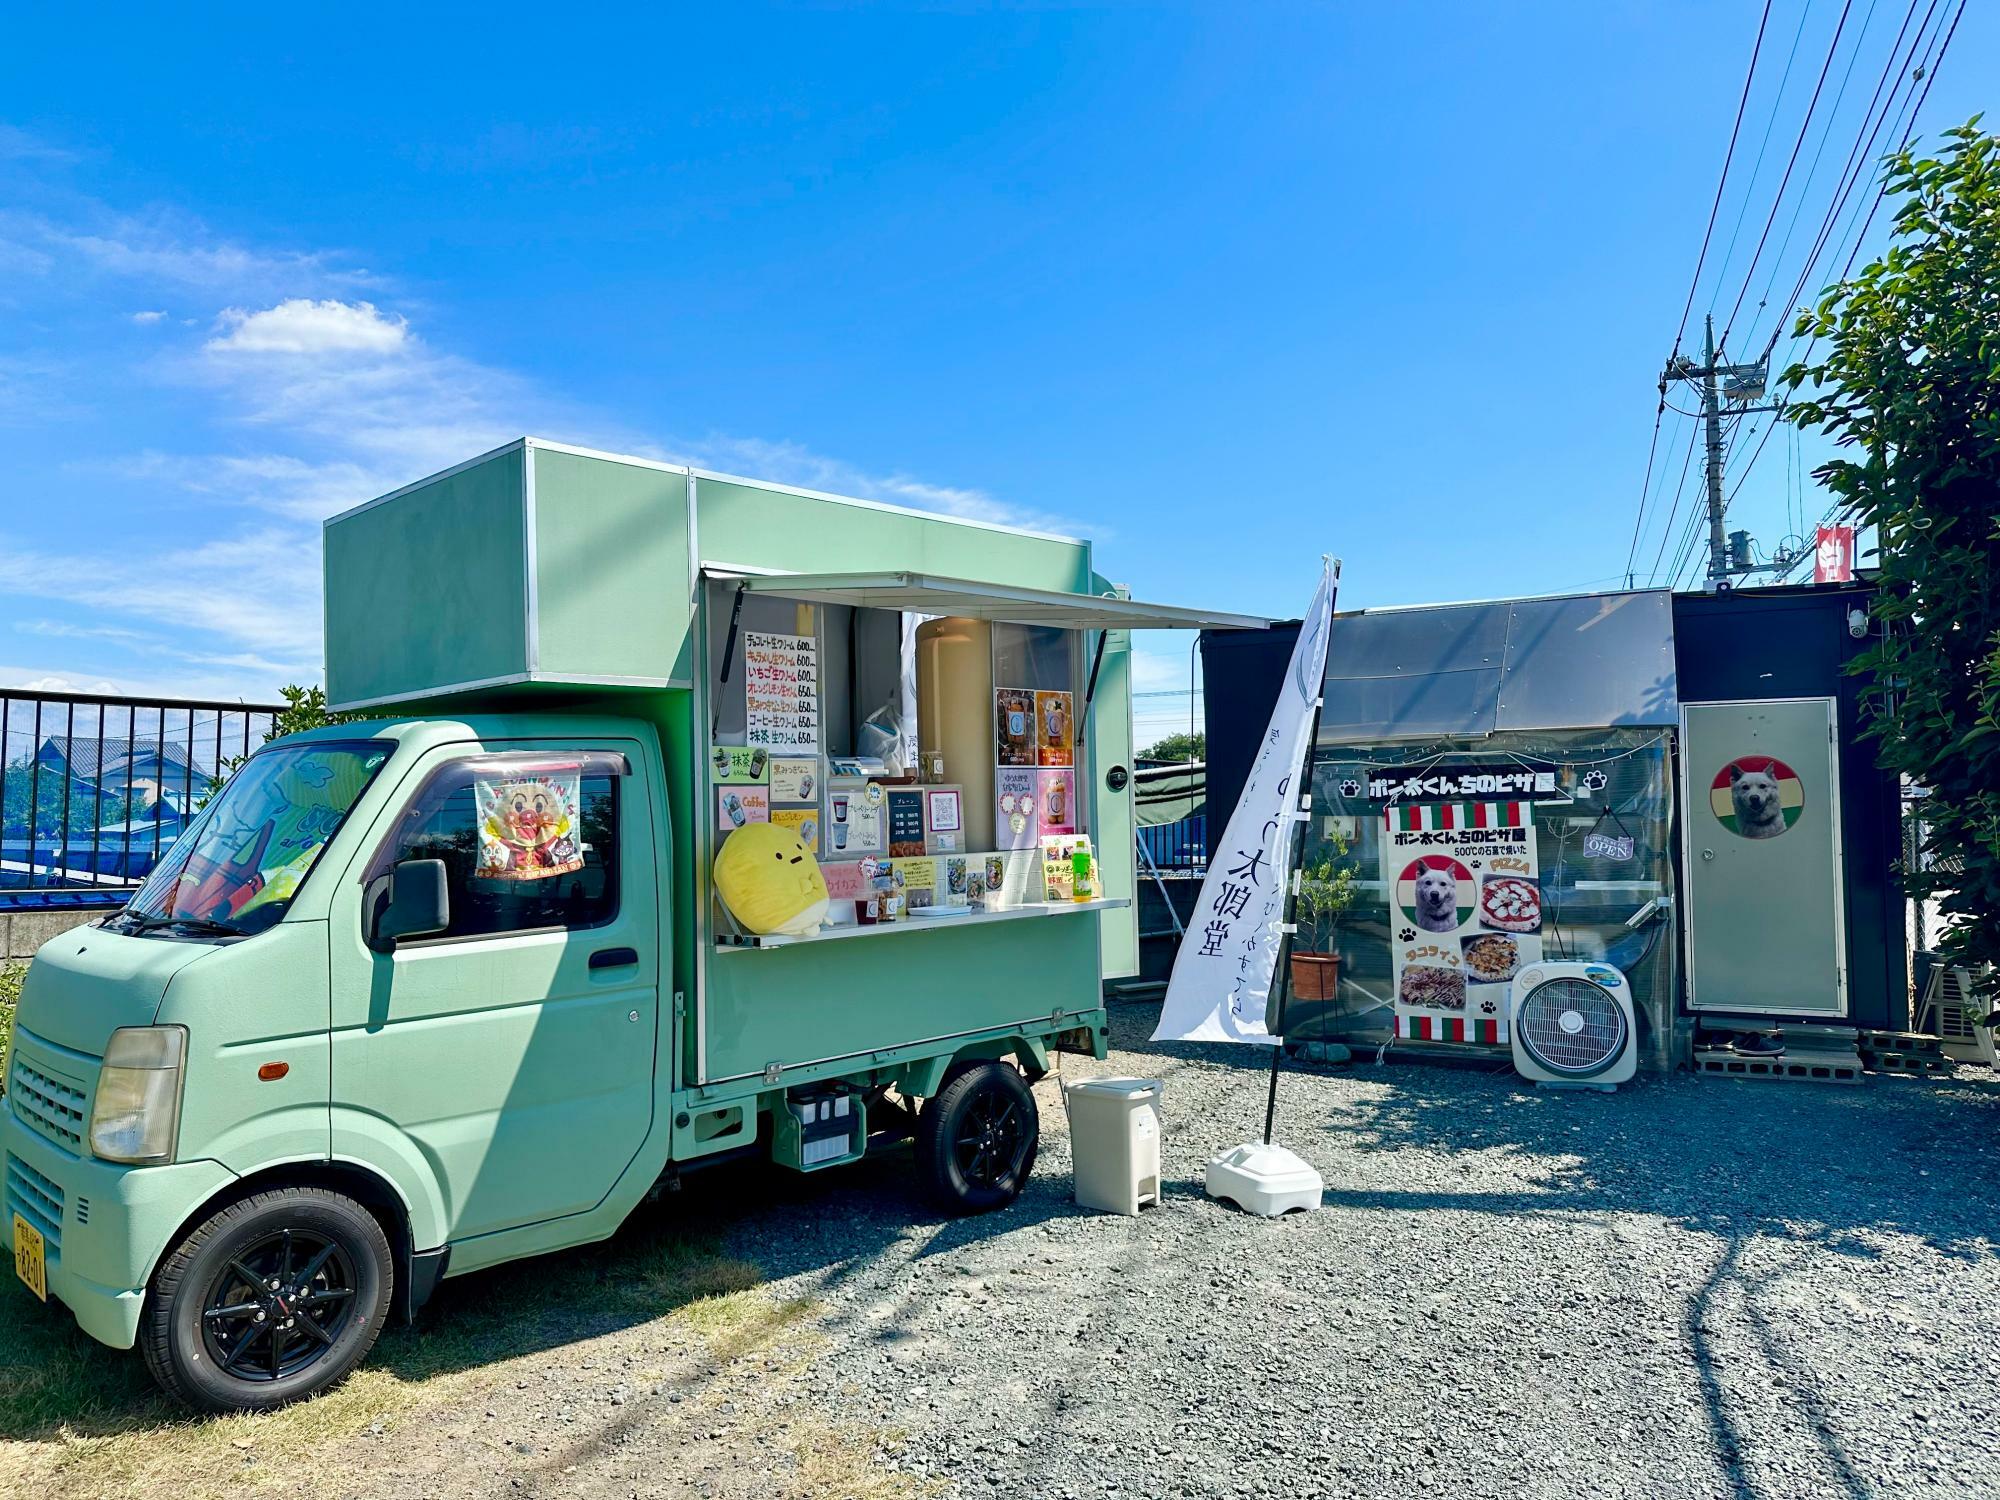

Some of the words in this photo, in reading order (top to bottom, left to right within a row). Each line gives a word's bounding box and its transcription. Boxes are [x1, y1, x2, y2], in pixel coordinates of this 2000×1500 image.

[748, 666, 797, 682] いちご生クリーム
[750, 713, 797, 729] コーヒー生クリーム
[731, 752, 750, 767] 抹茶
[1369, 772, 1556, 798] ポン太くんちのピザ屋
[1394, 828, 1526, 846] ポン太くんちのピザ屋
[1589, 839, 1628, 857] OPEN
[1489, 857, 1530, 875] PIZZA
[1405, 945, 1460, 967] タコライス
